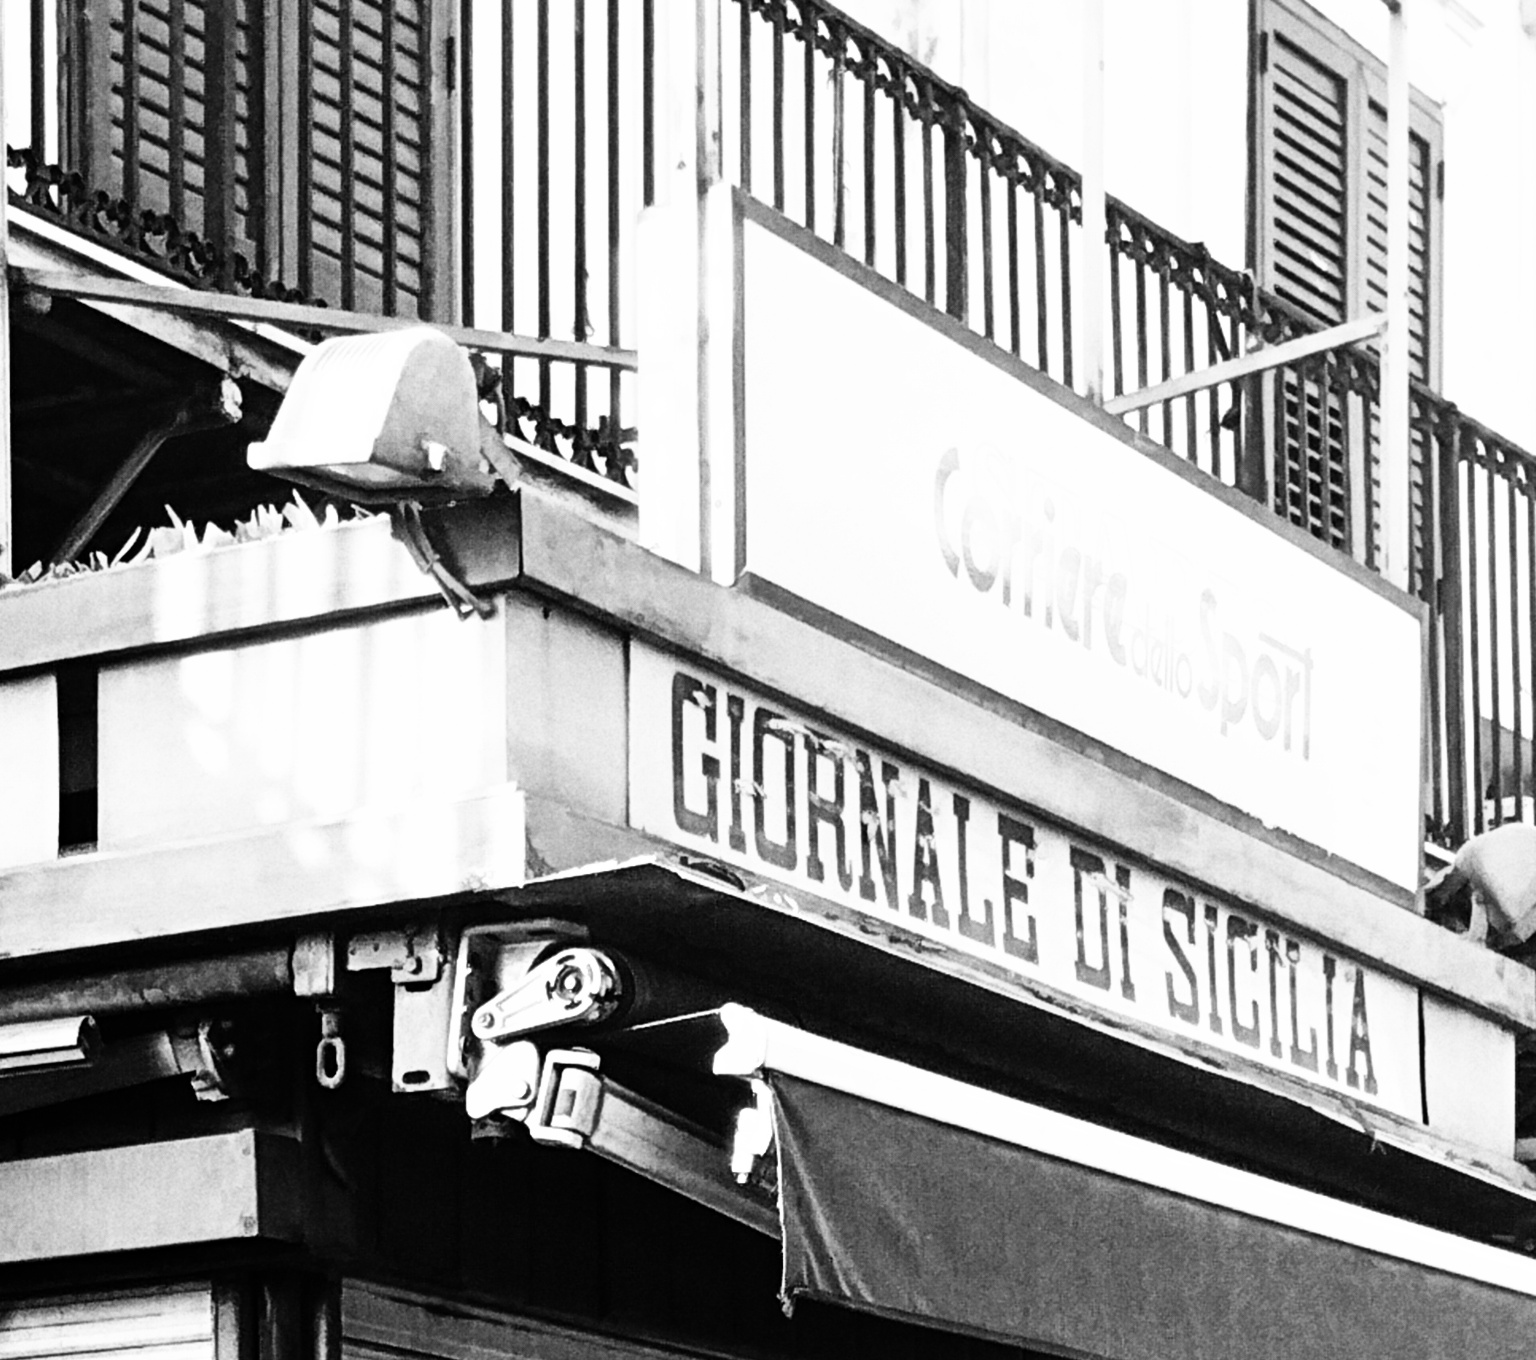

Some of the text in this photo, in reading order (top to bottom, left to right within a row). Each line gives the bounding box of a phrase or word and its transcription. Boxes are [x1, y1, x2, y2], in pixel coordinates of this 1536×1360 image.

[934, 447, 1127, 667] Corriere
[1197, 588, 1313, 762] Sport
[670, 671, 1378, 1097] GIORNALE DI SICILIA
